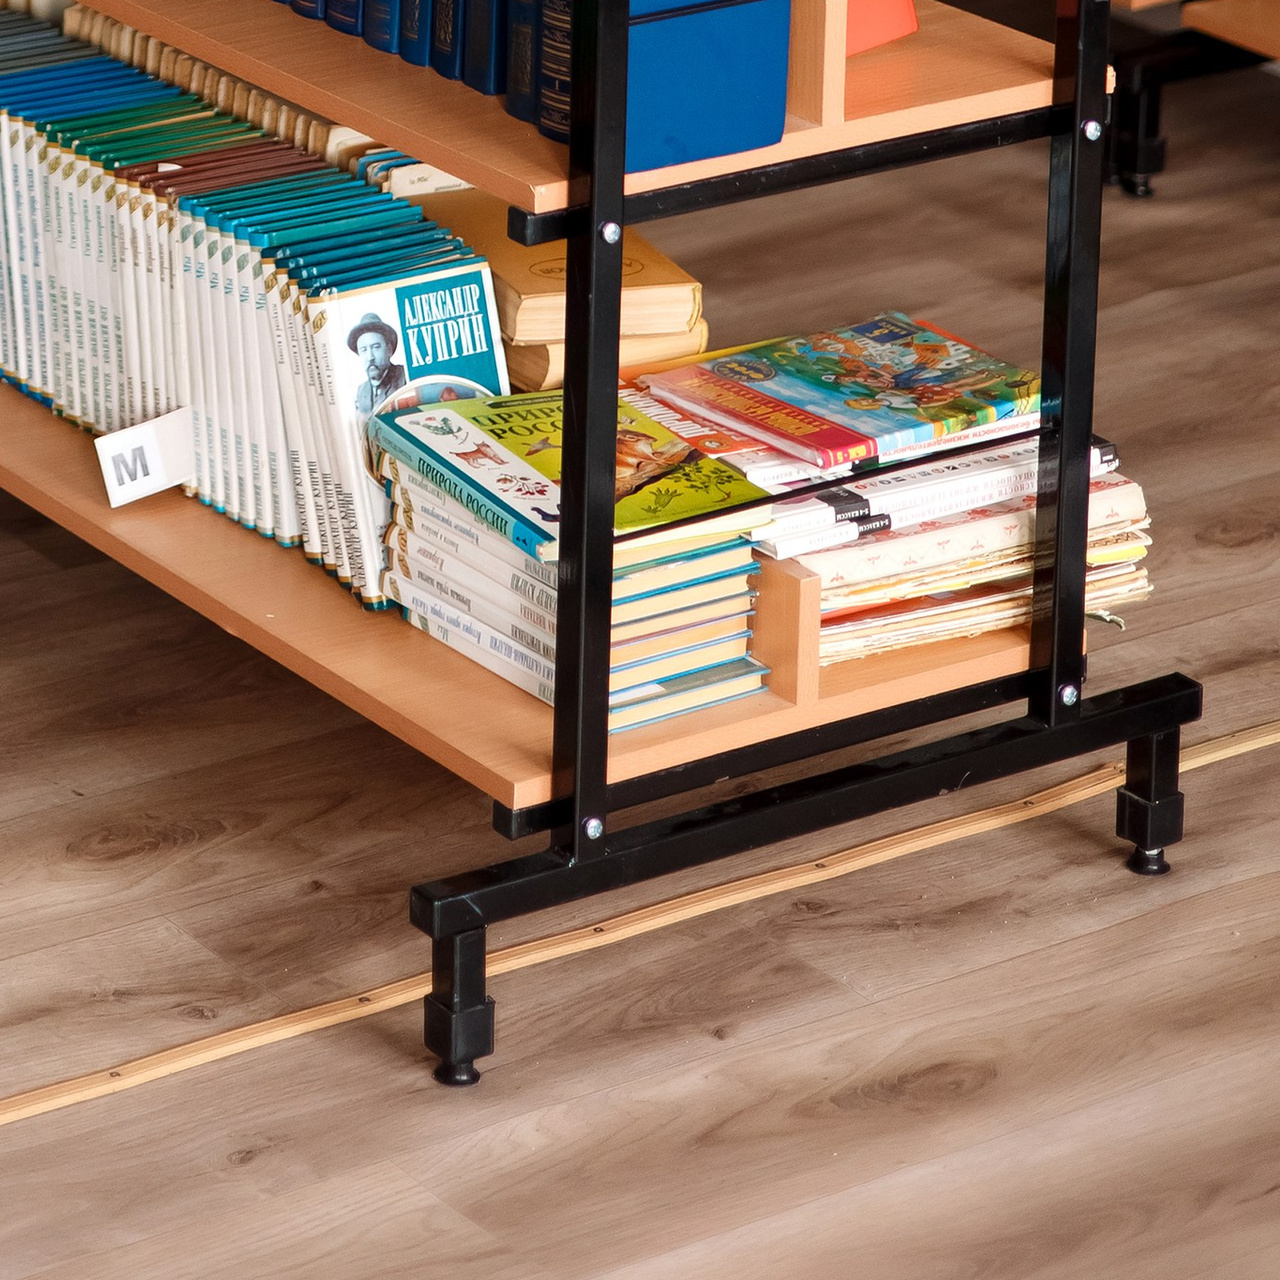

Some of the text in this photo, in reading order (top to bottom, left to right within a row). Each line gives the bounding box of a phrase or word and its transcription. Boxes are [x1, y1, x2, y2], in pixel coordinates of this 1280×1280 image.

[183, 257, 192, 273] Мы
[195, 262, 205, 279] Мы
[209, 273, 219, 290] Мы
[224, 279, 234, 296] Мы
[240, 286, 250, 303] Мы
[256, 293, 266, 310] Мы
[404, 283, 480, 327] АЛЕКСАНДР
[406, 313, 489, 367] КУПРИН
[881, 420, 1031, 458] безопасности жизнедеятельности
[112, 445, 151, 486] М
[290, 449, 310, 546] АЛЕКСАНДР КУПРИН
[307, 461, 330, 558] АЛЕКСАНДР КУПРИН
[418, 457, 508, 536] ПРИРОДА РОССИИ
[322, 473, 344, 569] АЛЕКСАНДР КУПРИН
[344, 492, 367, 590] АЛЕКСАНДР КУПРИН
[509, 572, 536, 598] КУПРИН
